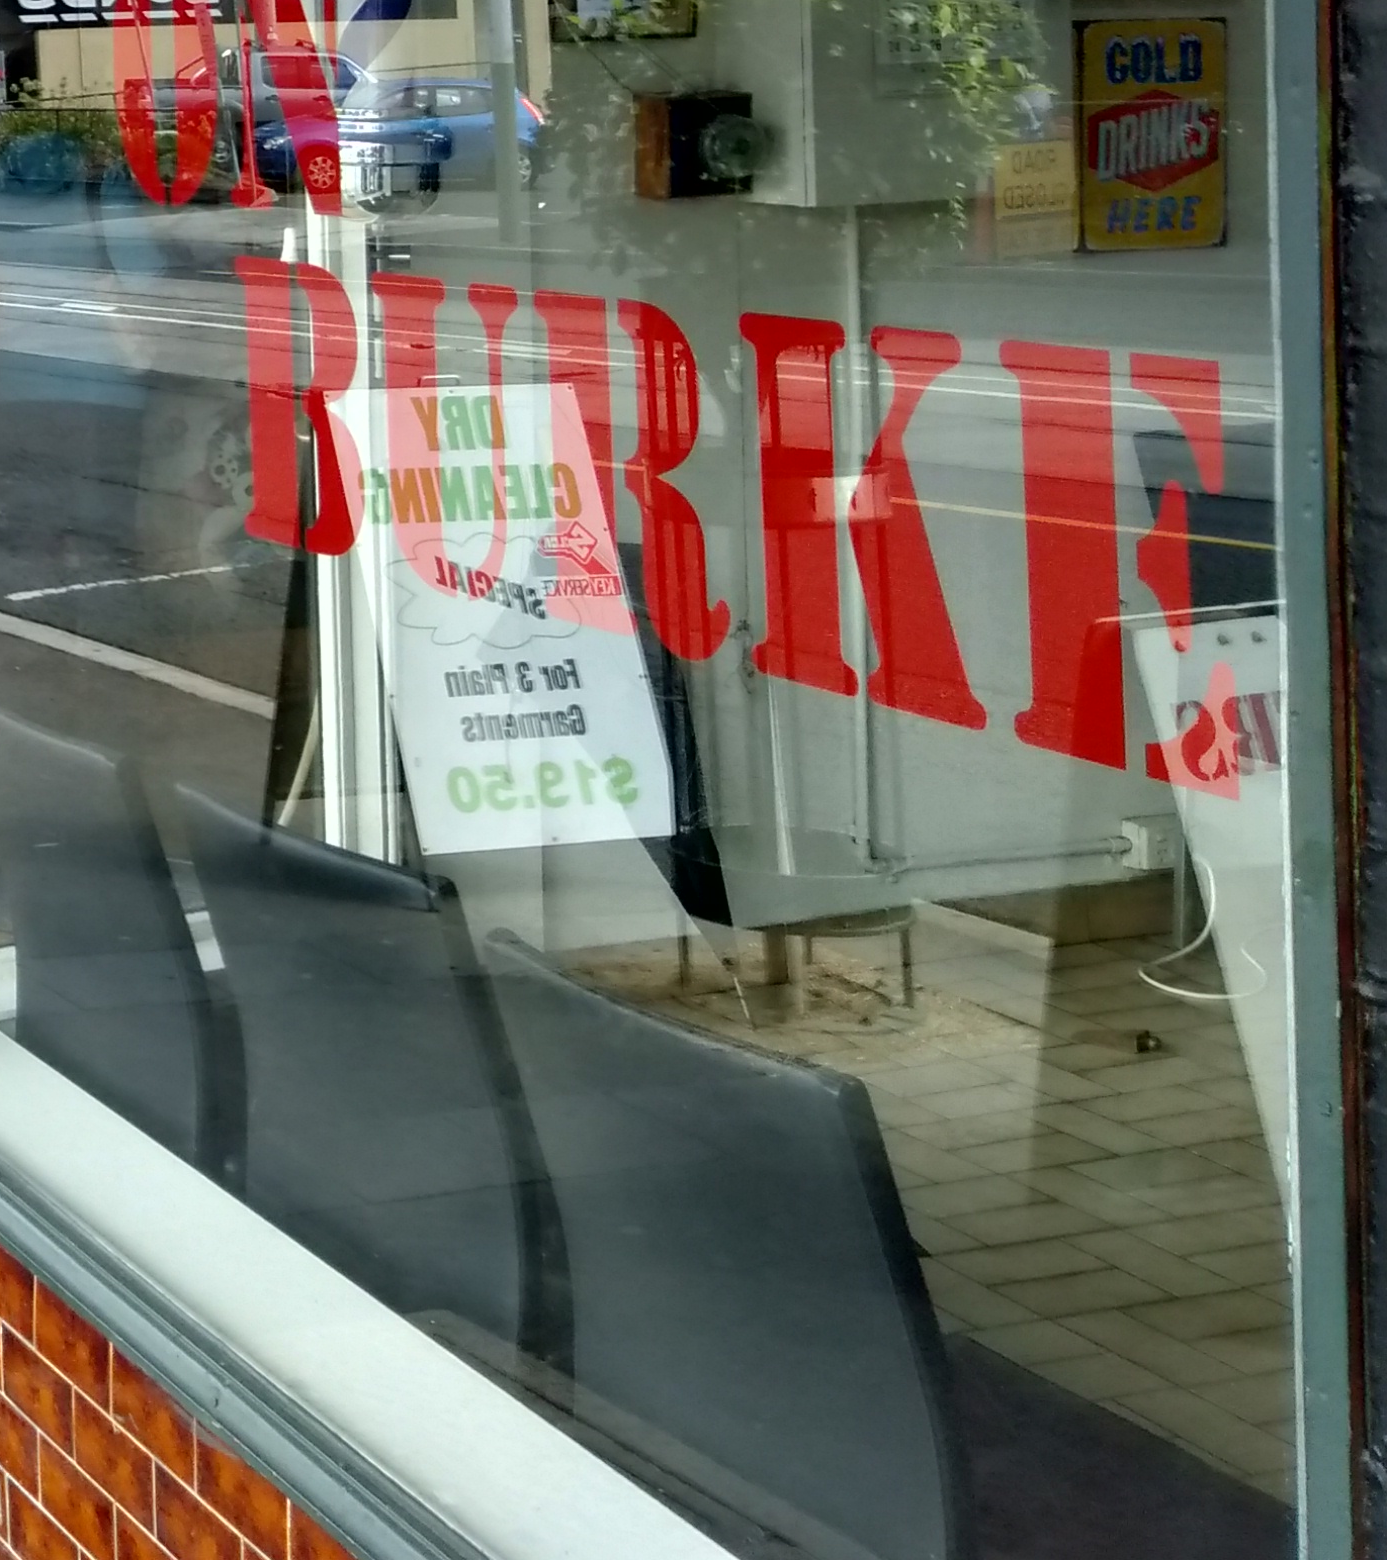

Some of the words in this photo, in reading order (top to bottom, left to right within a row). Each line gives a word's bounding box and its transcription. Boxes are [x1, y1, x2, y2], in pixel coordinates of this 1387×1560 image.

[1106, 33, 1203, 84] COLD
[1097, 100, 1212, 182] DRINKS
[1106, 196, 1203, 234] HERE
[231, 256, 1241, 800] BURKE
